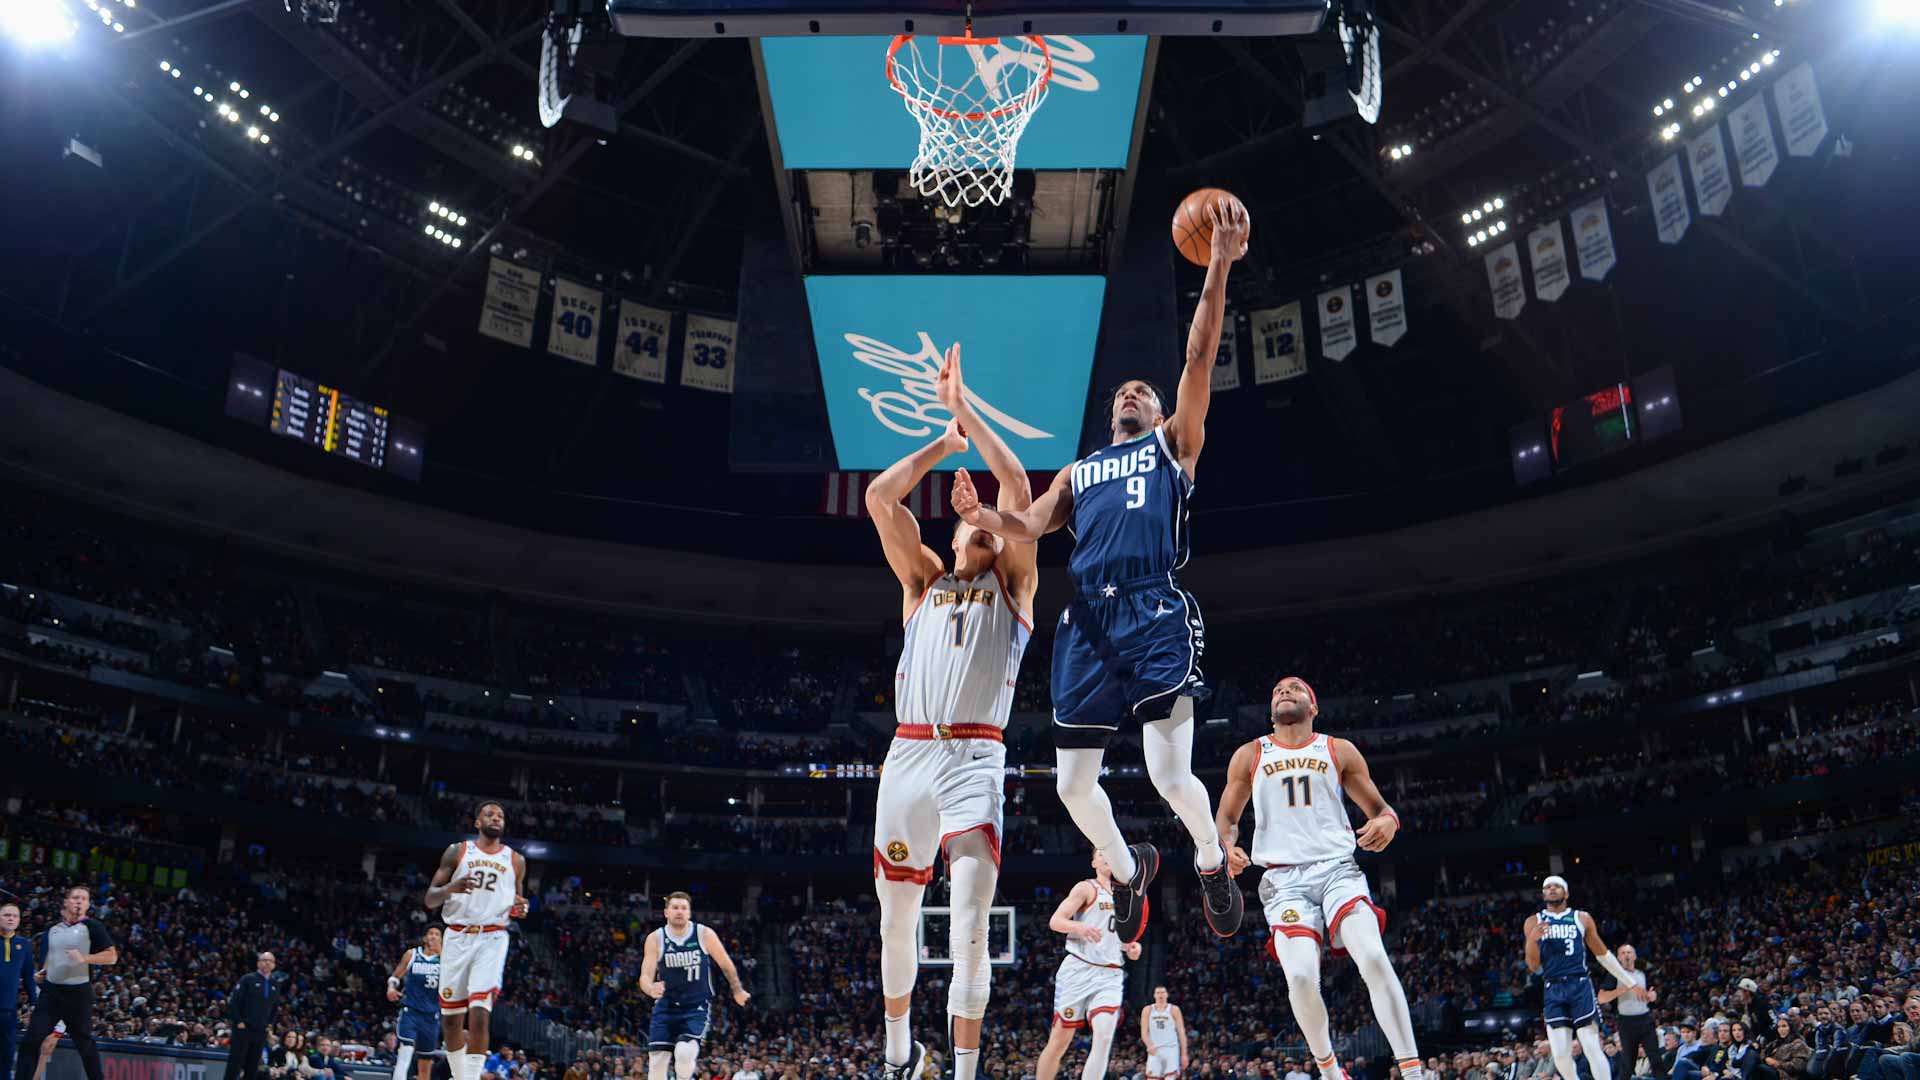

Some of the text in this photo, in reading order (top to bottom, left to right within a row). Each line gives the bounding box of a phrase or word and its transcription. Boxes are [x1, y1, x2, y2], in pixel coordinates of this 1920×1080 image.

[557, 311, 593, 340] 40
[625, 331, 658, 358] 44
[693, 343, 726, 369] 33
[1265, 333, 1294, 359] 12
[1076, 444, 1156, 494] MAVS
[1126, 476, 1146, 509] 9
[950, 609, 966, 649] 1
[1262, 757, 1329, 777] DENVER
[1281, 775, 1313, 809] 11
[467, 860, 507, 875] DENVER
[474, 870, 498, 892] 32
[664, 949, 702, 969] MAVS
[1564, 938, 1575, 956] 3
[412, 962, 440, 975] MAVS
[684, 965, 701, 983] 77
